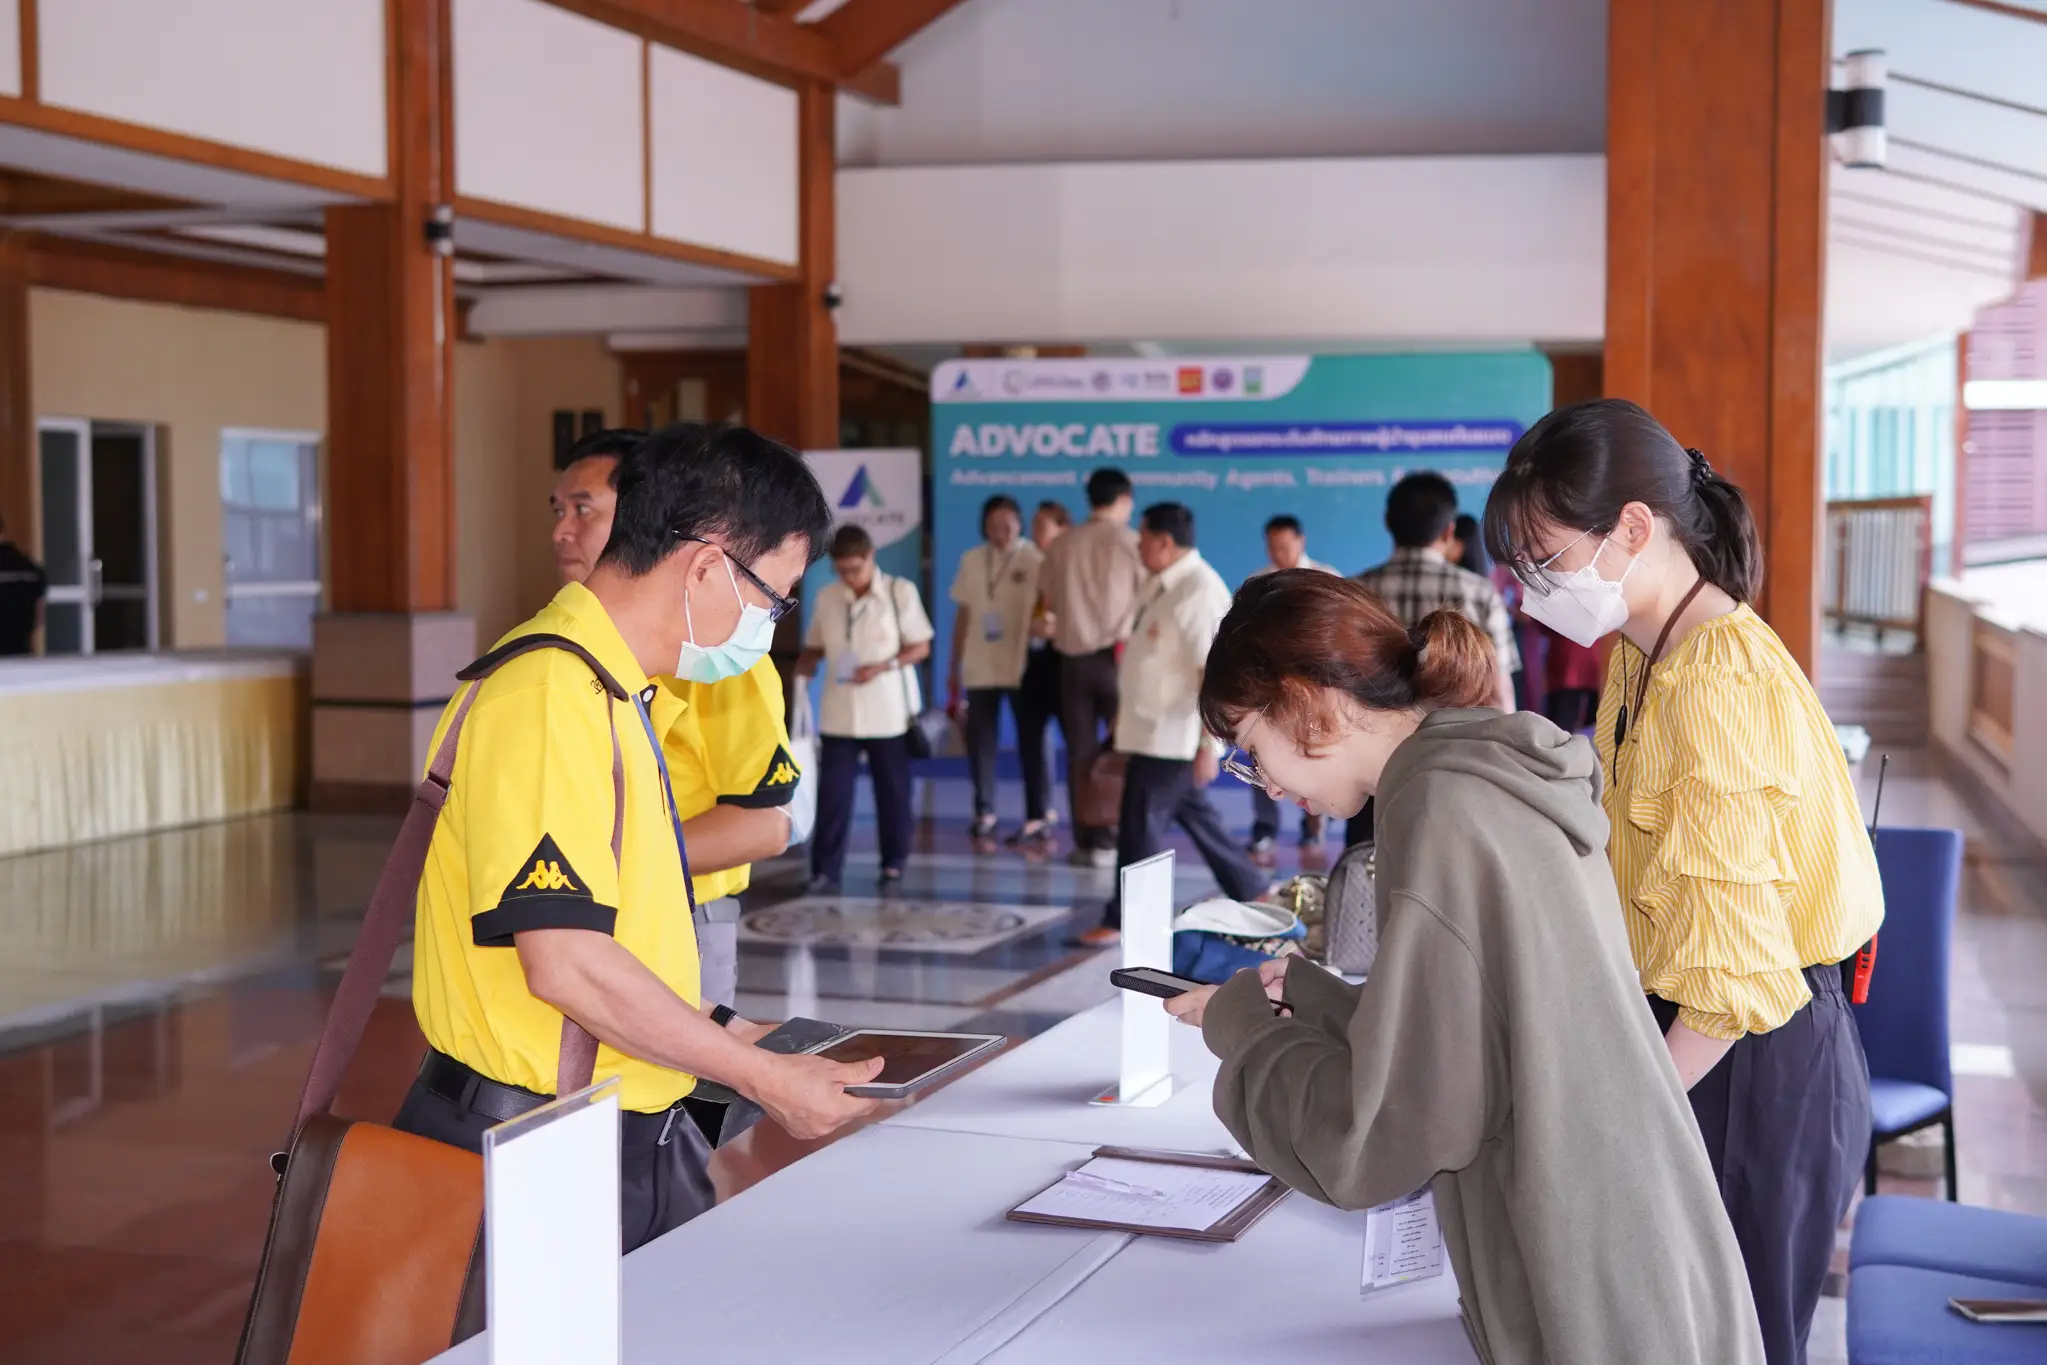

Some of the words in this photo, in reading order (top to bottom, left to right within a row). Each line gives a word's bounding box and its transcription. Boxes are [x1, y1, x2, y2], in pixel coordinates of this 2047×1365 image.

[950, 423, 1160, 457] ADVOCATE
[950, 467, 1078, 487] Advancement
[1127, 469, 1219, 491] ommunity
